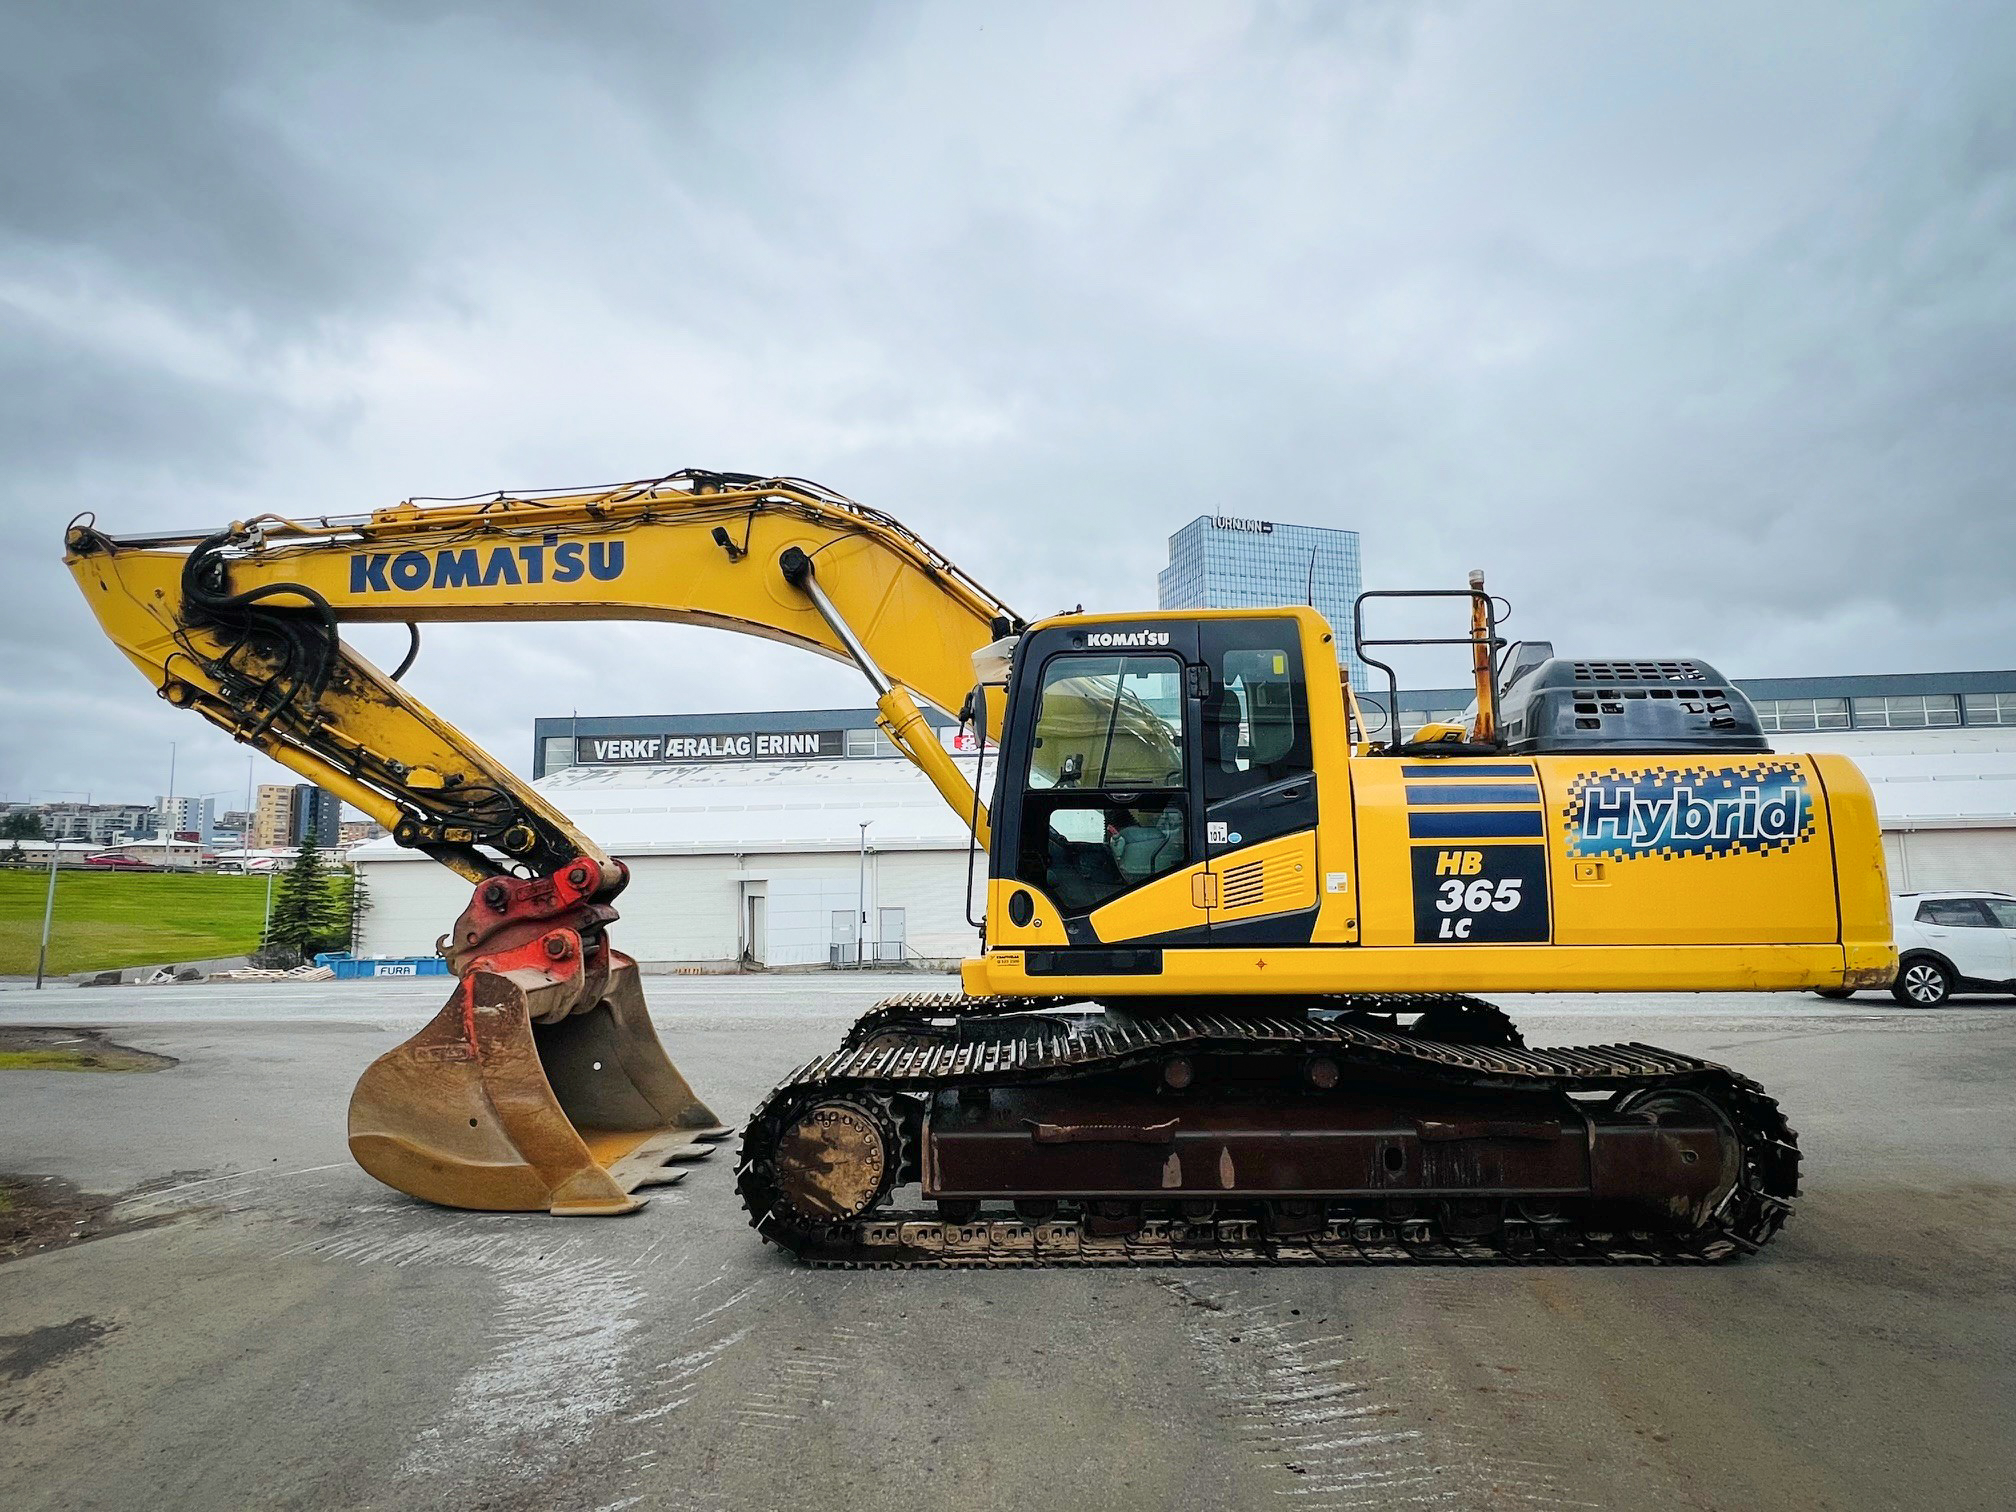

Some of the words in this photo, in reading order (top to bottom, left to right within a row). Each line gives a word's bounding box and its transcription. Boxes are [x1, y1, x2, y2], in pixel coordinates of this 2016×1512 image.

[350, 534, 625, 594] KOMATSU
[1087, 629, 1170, 647] KOMATSU
[1581, 785, 1803, 848] Hybrid
[1435, 850, 1483, 877] HB
[1435, 878, 1523, 913] 365
[1438, 917, 1473, 940] LC
[380, 966, 411, 975] FURA
